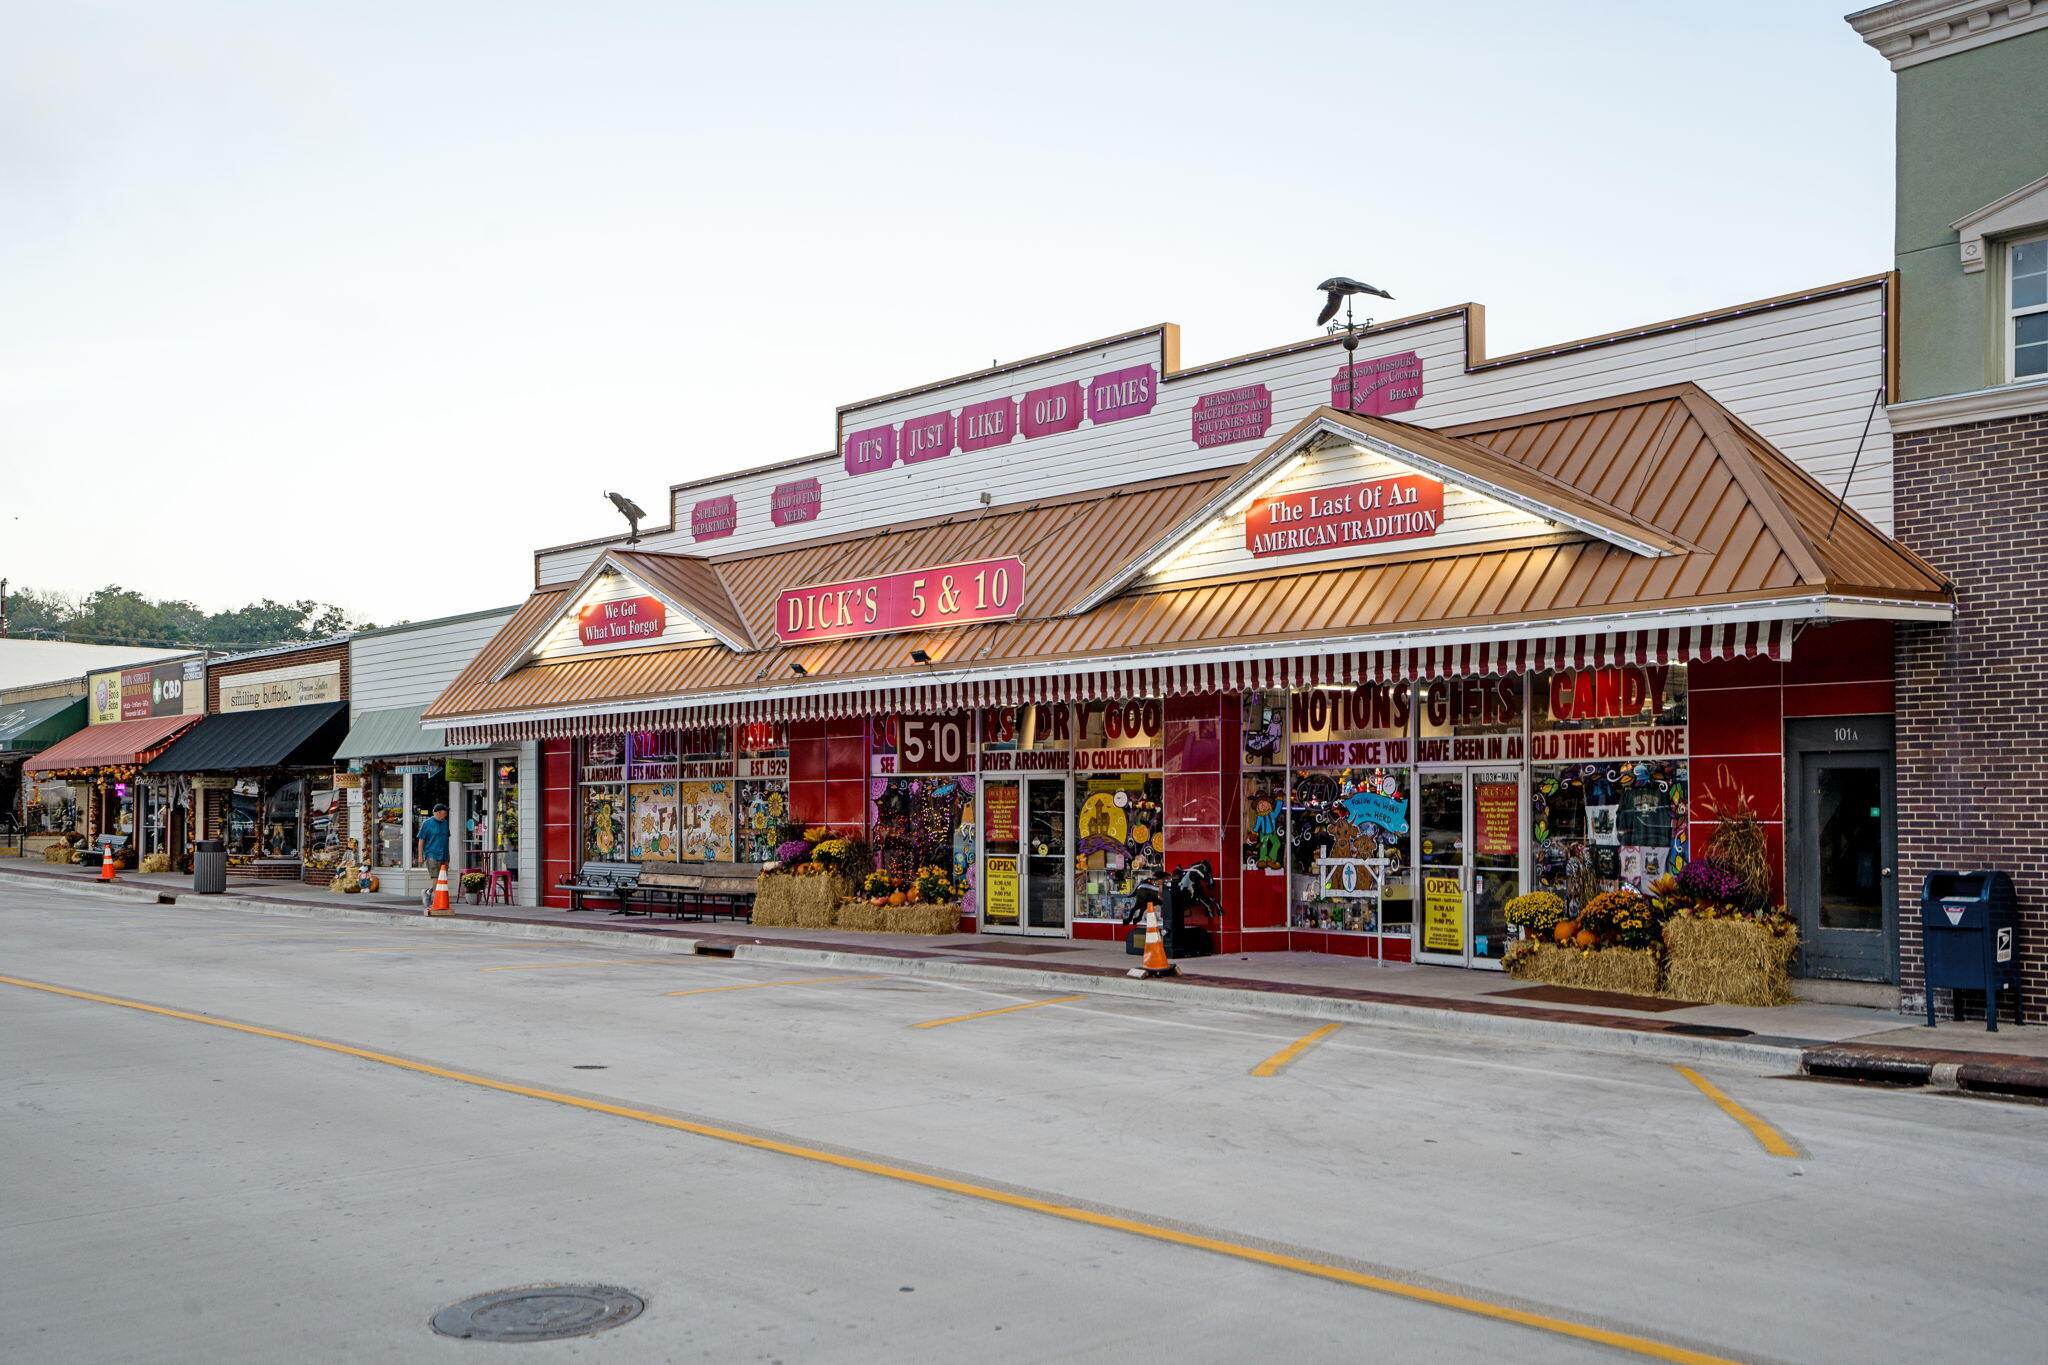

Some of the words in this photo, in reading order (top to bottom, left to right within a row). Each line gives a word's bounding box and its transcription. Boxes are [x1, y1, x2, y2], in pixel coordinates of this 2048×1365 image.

[1376, 356, 1416, 373] MISSOURI
[1095, 376, 1149, 412] TIMES
[1333, 382, 1359, 393] WHEE
[1205, 388, 1256, 408] REASONABLY
[1035, 396, 1067, 424] OLD
[1194, 408, 1223, 422] PRICED
[1226, 403, 1248, 416] GIFTS
[1252, 399, 1268, 411] AND
[968, 410, 1004, 440] LIKE
[1198, 417, 1244, 434] SOUVENIRS
[1247, 412, 1264, 424] ARE
[910, 424, 944, 456] JUST
[1200, 434, 1216, 446] OUR
[1218, 426, 1262, 443] SPECIALTY
[858, 438, 882, 463] IT'S
[771, 496, 791, 510] HARD
[793, 495, 802, 506] TO
[802, 491, 820, 504] FIND
[1268, 502, 1302, 524] The
[1310, 494, 1352, 518] Last
[1359, 486, 1382, 510] Of
[1388, 484, 1418, 506] An
[696, 508, 716, 520] SUPER
[718, 504, 731, 516] TOY
[784, 508, 807, 522] NEEDS
[692, 518, 735, 536] DEPARTMENT
[1253, 524, 1338, 554] AMERICAN
[1342, 510, 1436, 542] TRADITION
[787, 586, 877, 632] DICK'S
[911, 578, 926, 616] 5
[938, 575, 960, 614] &
[974, 567, 1008, 610] 10
[605, 604, 618, 618] We
[621, 602, 637, 617] Got
[586, 626, 608, 640] What
[610, 623, 626, 637] You
[629, 619, 658, 636] Forgot
[122, 675, 132, 686] MAIN
[134, 672, 150, 683] STREET
[163, 680, 181, 700] CBD
[231, 692, 260, 708] smiling
[1551, 666, 1669, 719] CANDY
[1292, 684, 1410, 732] NOTIONS
[1428, 678, 1514, 726] GIFTS
[1036, 703, 1090, 740] DRY
[904, 722, 924, 763] 5
[930, 722, 960, 763] 10
[1291, 745, 1312, 766] HOW
[1316, 744, 1344, 765] LONG
[1349, 742, 1380, 764] SINCE
[1385, 740, 1407, 763] YOU
[1418, 740, 1449, 761] HAVE
[1454, 738, 1484, 760] BEEN
[1488, 738, 1502, 759] IN
[1532, 735, 1558, 760] OLD
[1564, 733, 1594, 758] TIME
[1598, 731, 1631, 757] DIME
[1636, 728, 1684, 756] STORE
[630, 766, 644, 780] LETS
[646, 764, 661, 780] MAKE
[700, 762, 713, 777] FUN
[751, 761, 765, 775] EST.
[768, 759, 787, 774] 1929
[880, 757, 894, 773] SEE
[984, 752, 1011, 770] RIVER
[1092, 749, 1152, 769] COLLECTION
[587, 766, 622, 782] LANDMARK
[1374, 811, 1392, 823] HERD
[1383, 802, 1399, 814] WORD
[989, 860, 1016, 871] OPEN
[1427, 880, 1460, 894] OPEN
